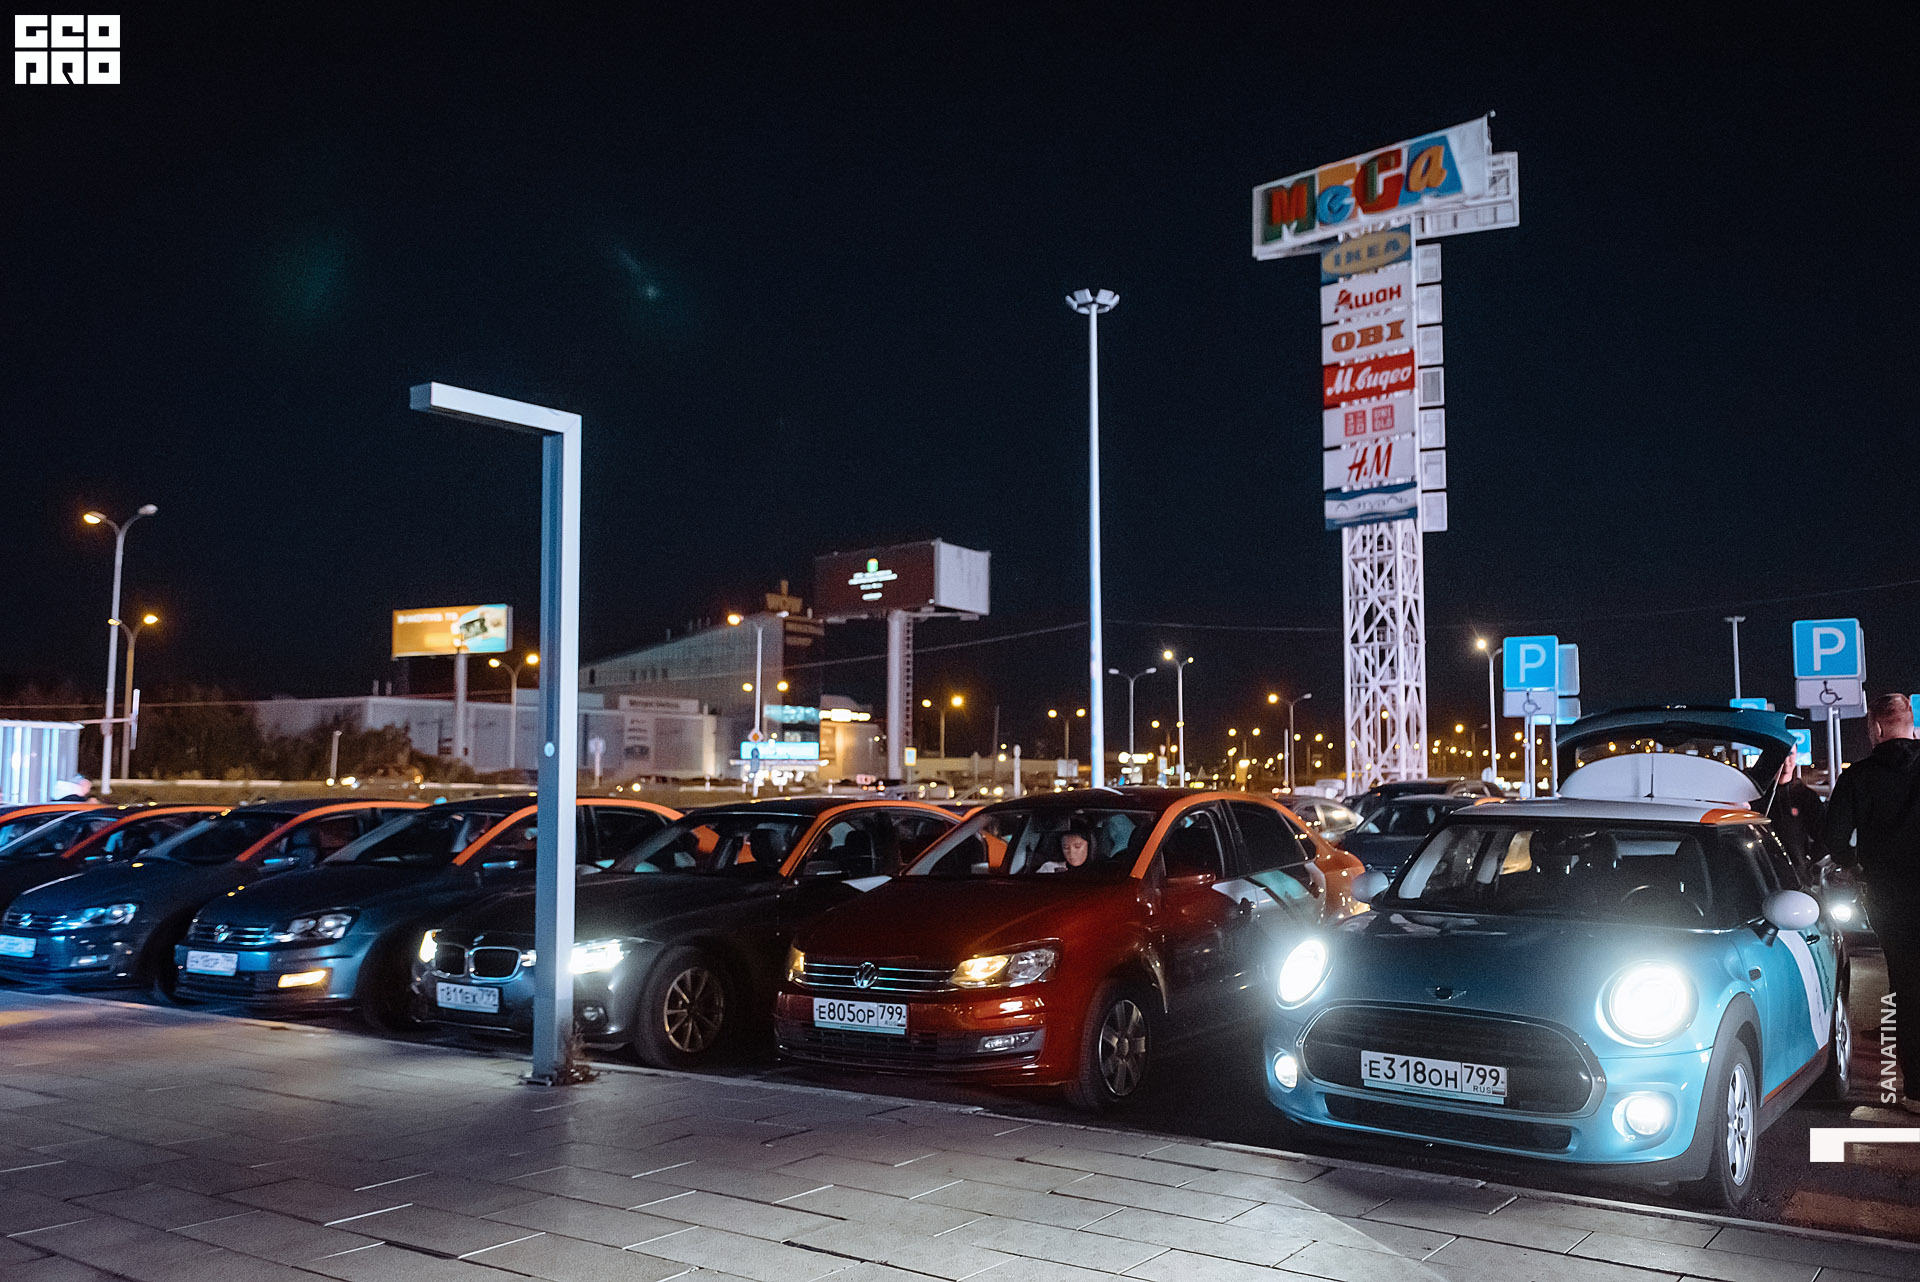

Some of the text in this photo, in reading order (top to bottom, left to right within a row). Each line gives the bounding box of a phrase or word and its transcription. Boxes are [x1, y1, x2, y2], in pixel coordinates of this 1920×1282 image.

[1333, 238, 1402, 268] IKEA
[1334, 284, 1402, 313] Ашан
[1331, 320, 1405, 352] OBI
[1520, 644, 1546, 683] P
[1812, 627, 1846, 671] P
[879, 1005, 903, 1020] 799
[1464, 1065, 1500, 1087] 799
[1473, 1084, 1492, 1094] RUS
